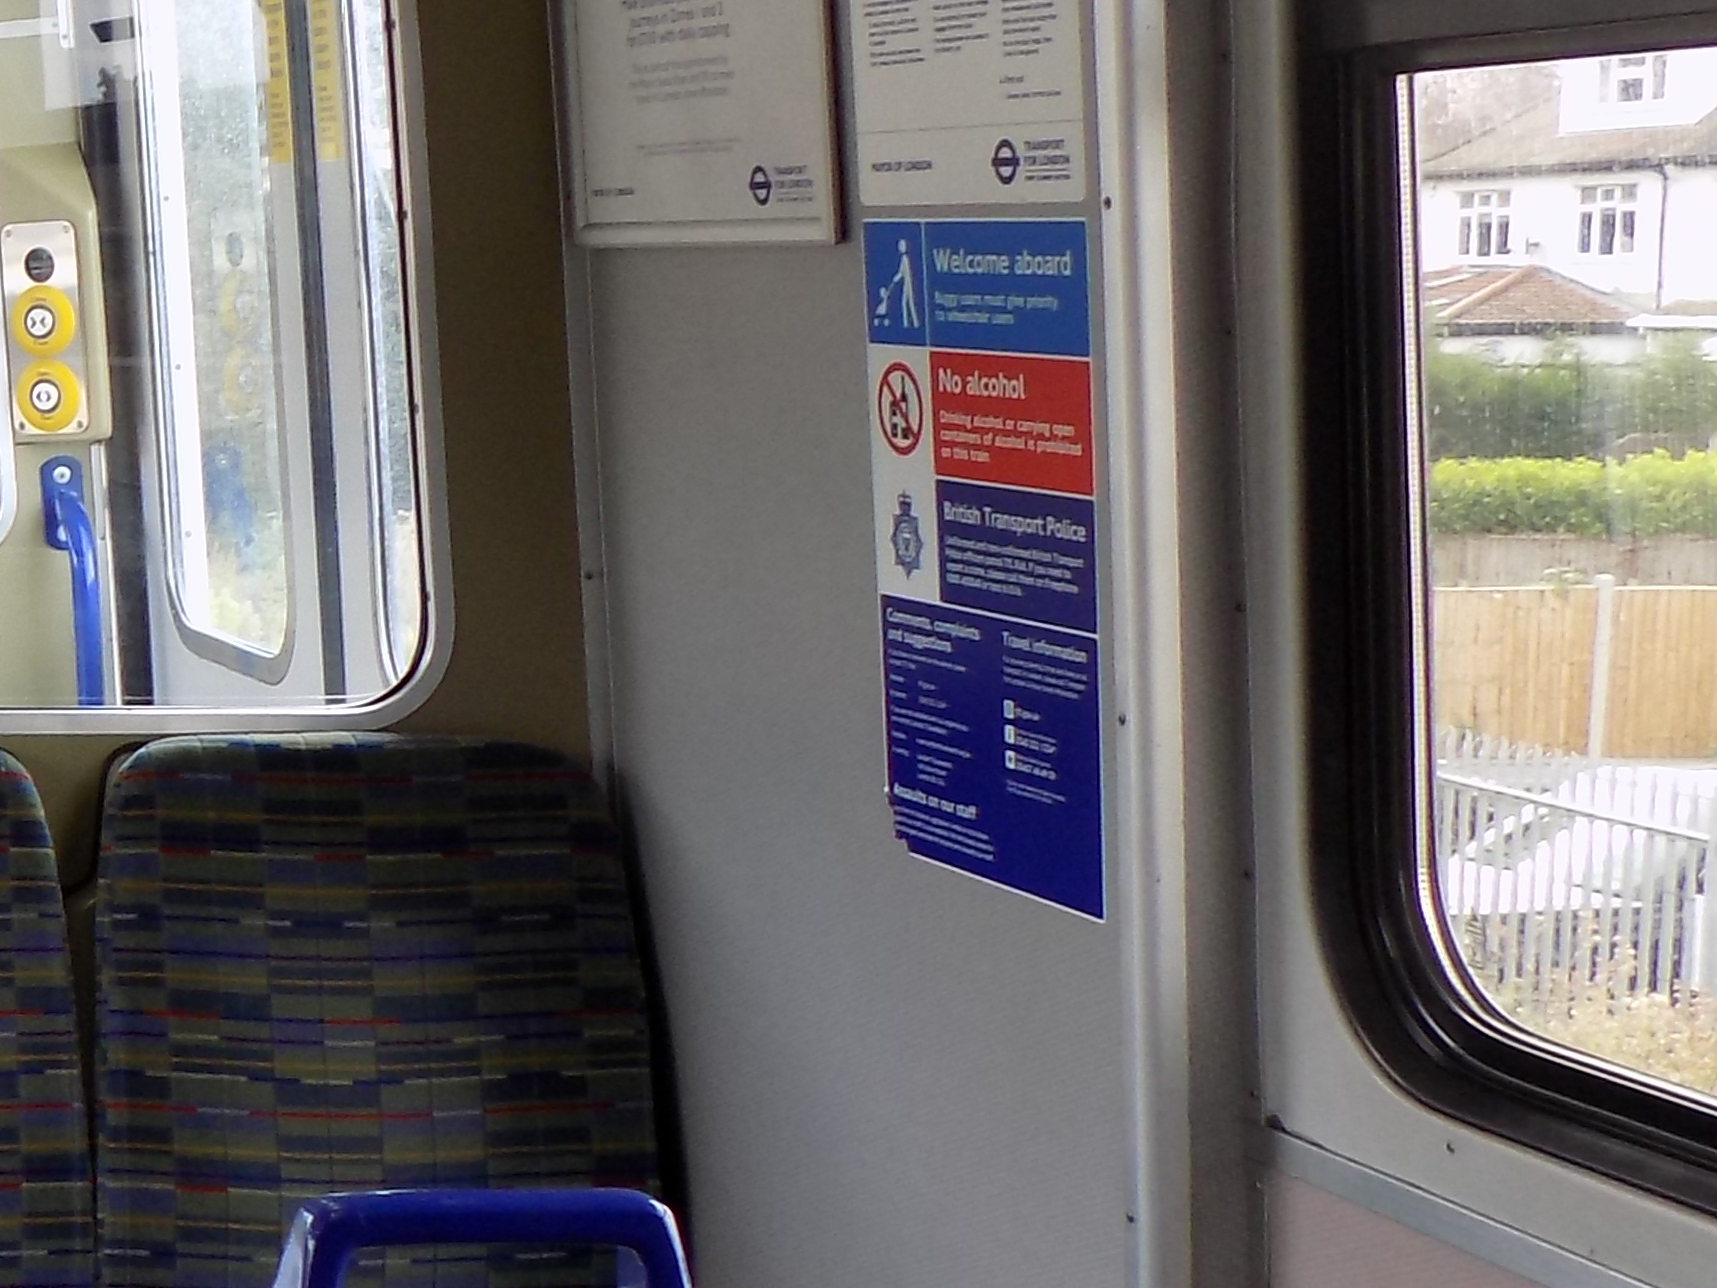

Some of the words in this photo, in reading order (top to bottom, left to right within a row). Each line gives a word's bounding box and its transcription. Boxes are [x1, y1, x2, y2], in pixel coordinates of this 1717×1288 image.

[933, 247, 1010, 274] Welcome
[1015, 249, 1072, 276] aboard
[938, 366, 963, 394] No
[966, 370, 1027, 400] alcohol
[943, 500, 981, 526] British
[982, 506, 1045, 537] Transport
[1046, 515, 1088, 542] Police
